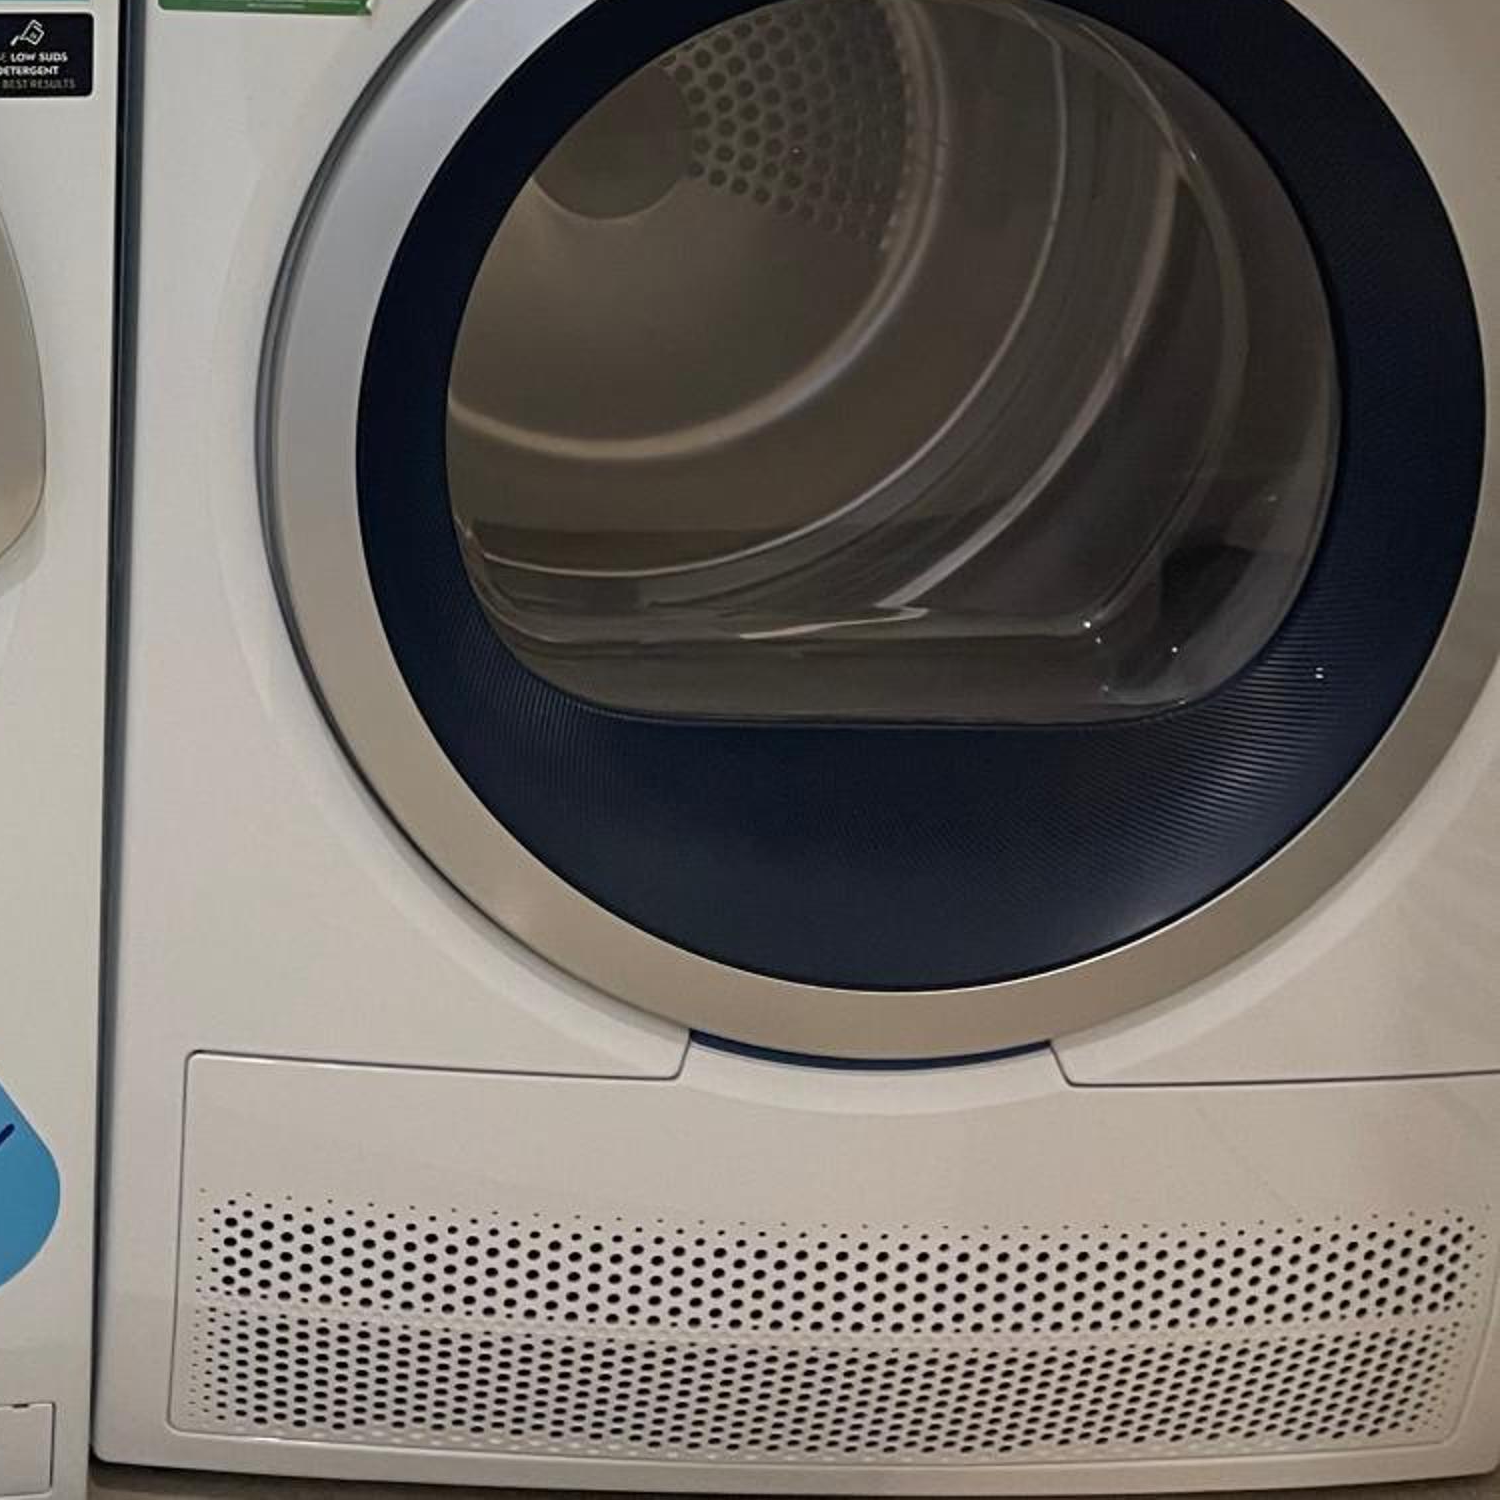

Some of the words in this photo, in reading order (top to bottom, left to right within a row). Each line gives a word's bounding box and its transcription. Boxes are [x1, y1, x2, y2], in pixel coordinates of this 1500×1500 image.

[10, 52, 37, 63] LOW
[38, 51, 68, 63] SUDS
[2, 79, 28, 90] BEST
